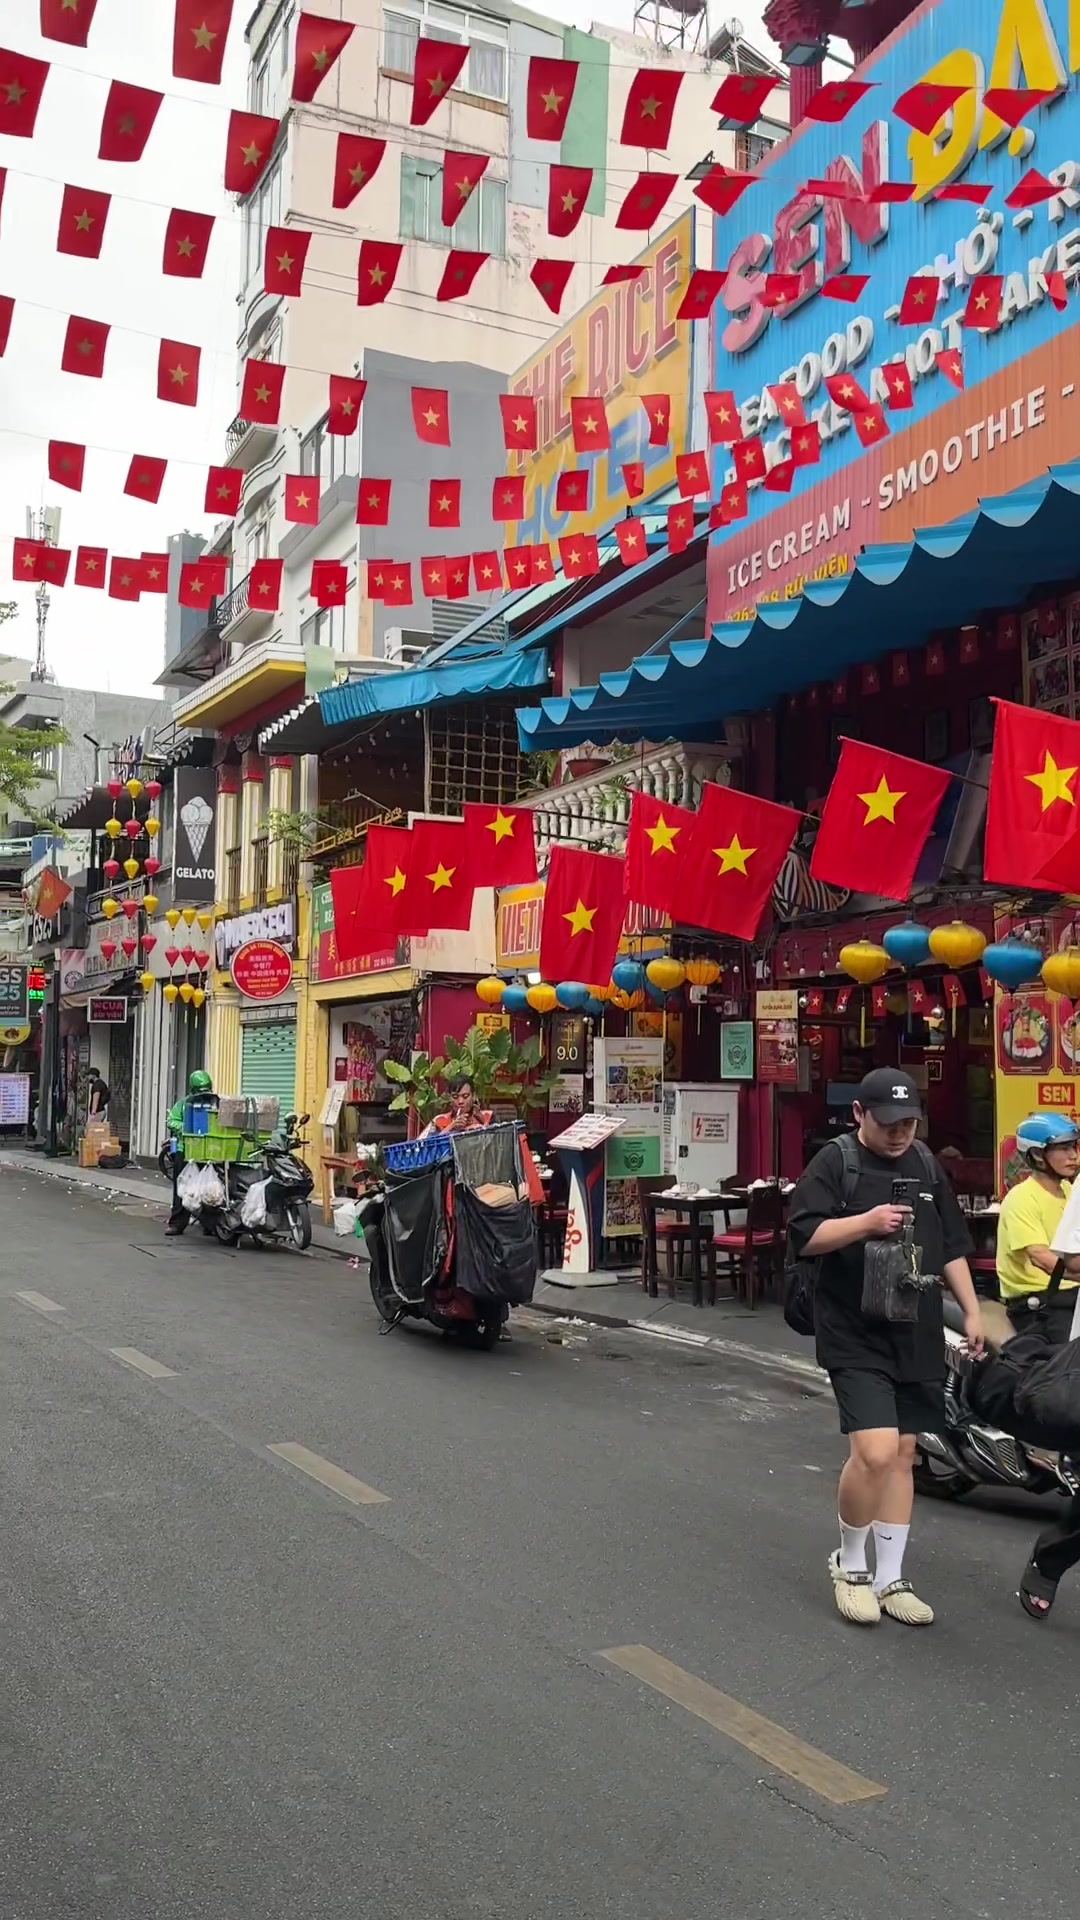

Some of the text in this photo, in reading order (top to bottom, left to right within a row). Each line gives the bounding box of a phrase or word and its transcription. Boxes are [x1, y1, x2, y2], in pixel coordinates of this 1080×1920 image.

[723, 120, 888, 352] SEN
[586, 235, 682, 403] RICE
[727, 550, 762, 595] ICE
[766, 496, 851, 570] CREAM
[878, 385, 1047, 511] SMOOTHIE
[176, 866, 215, 880] GELATO
[0, 984, 20, 1001] 25
[1042, 1085, 1071, 1103] SEN
